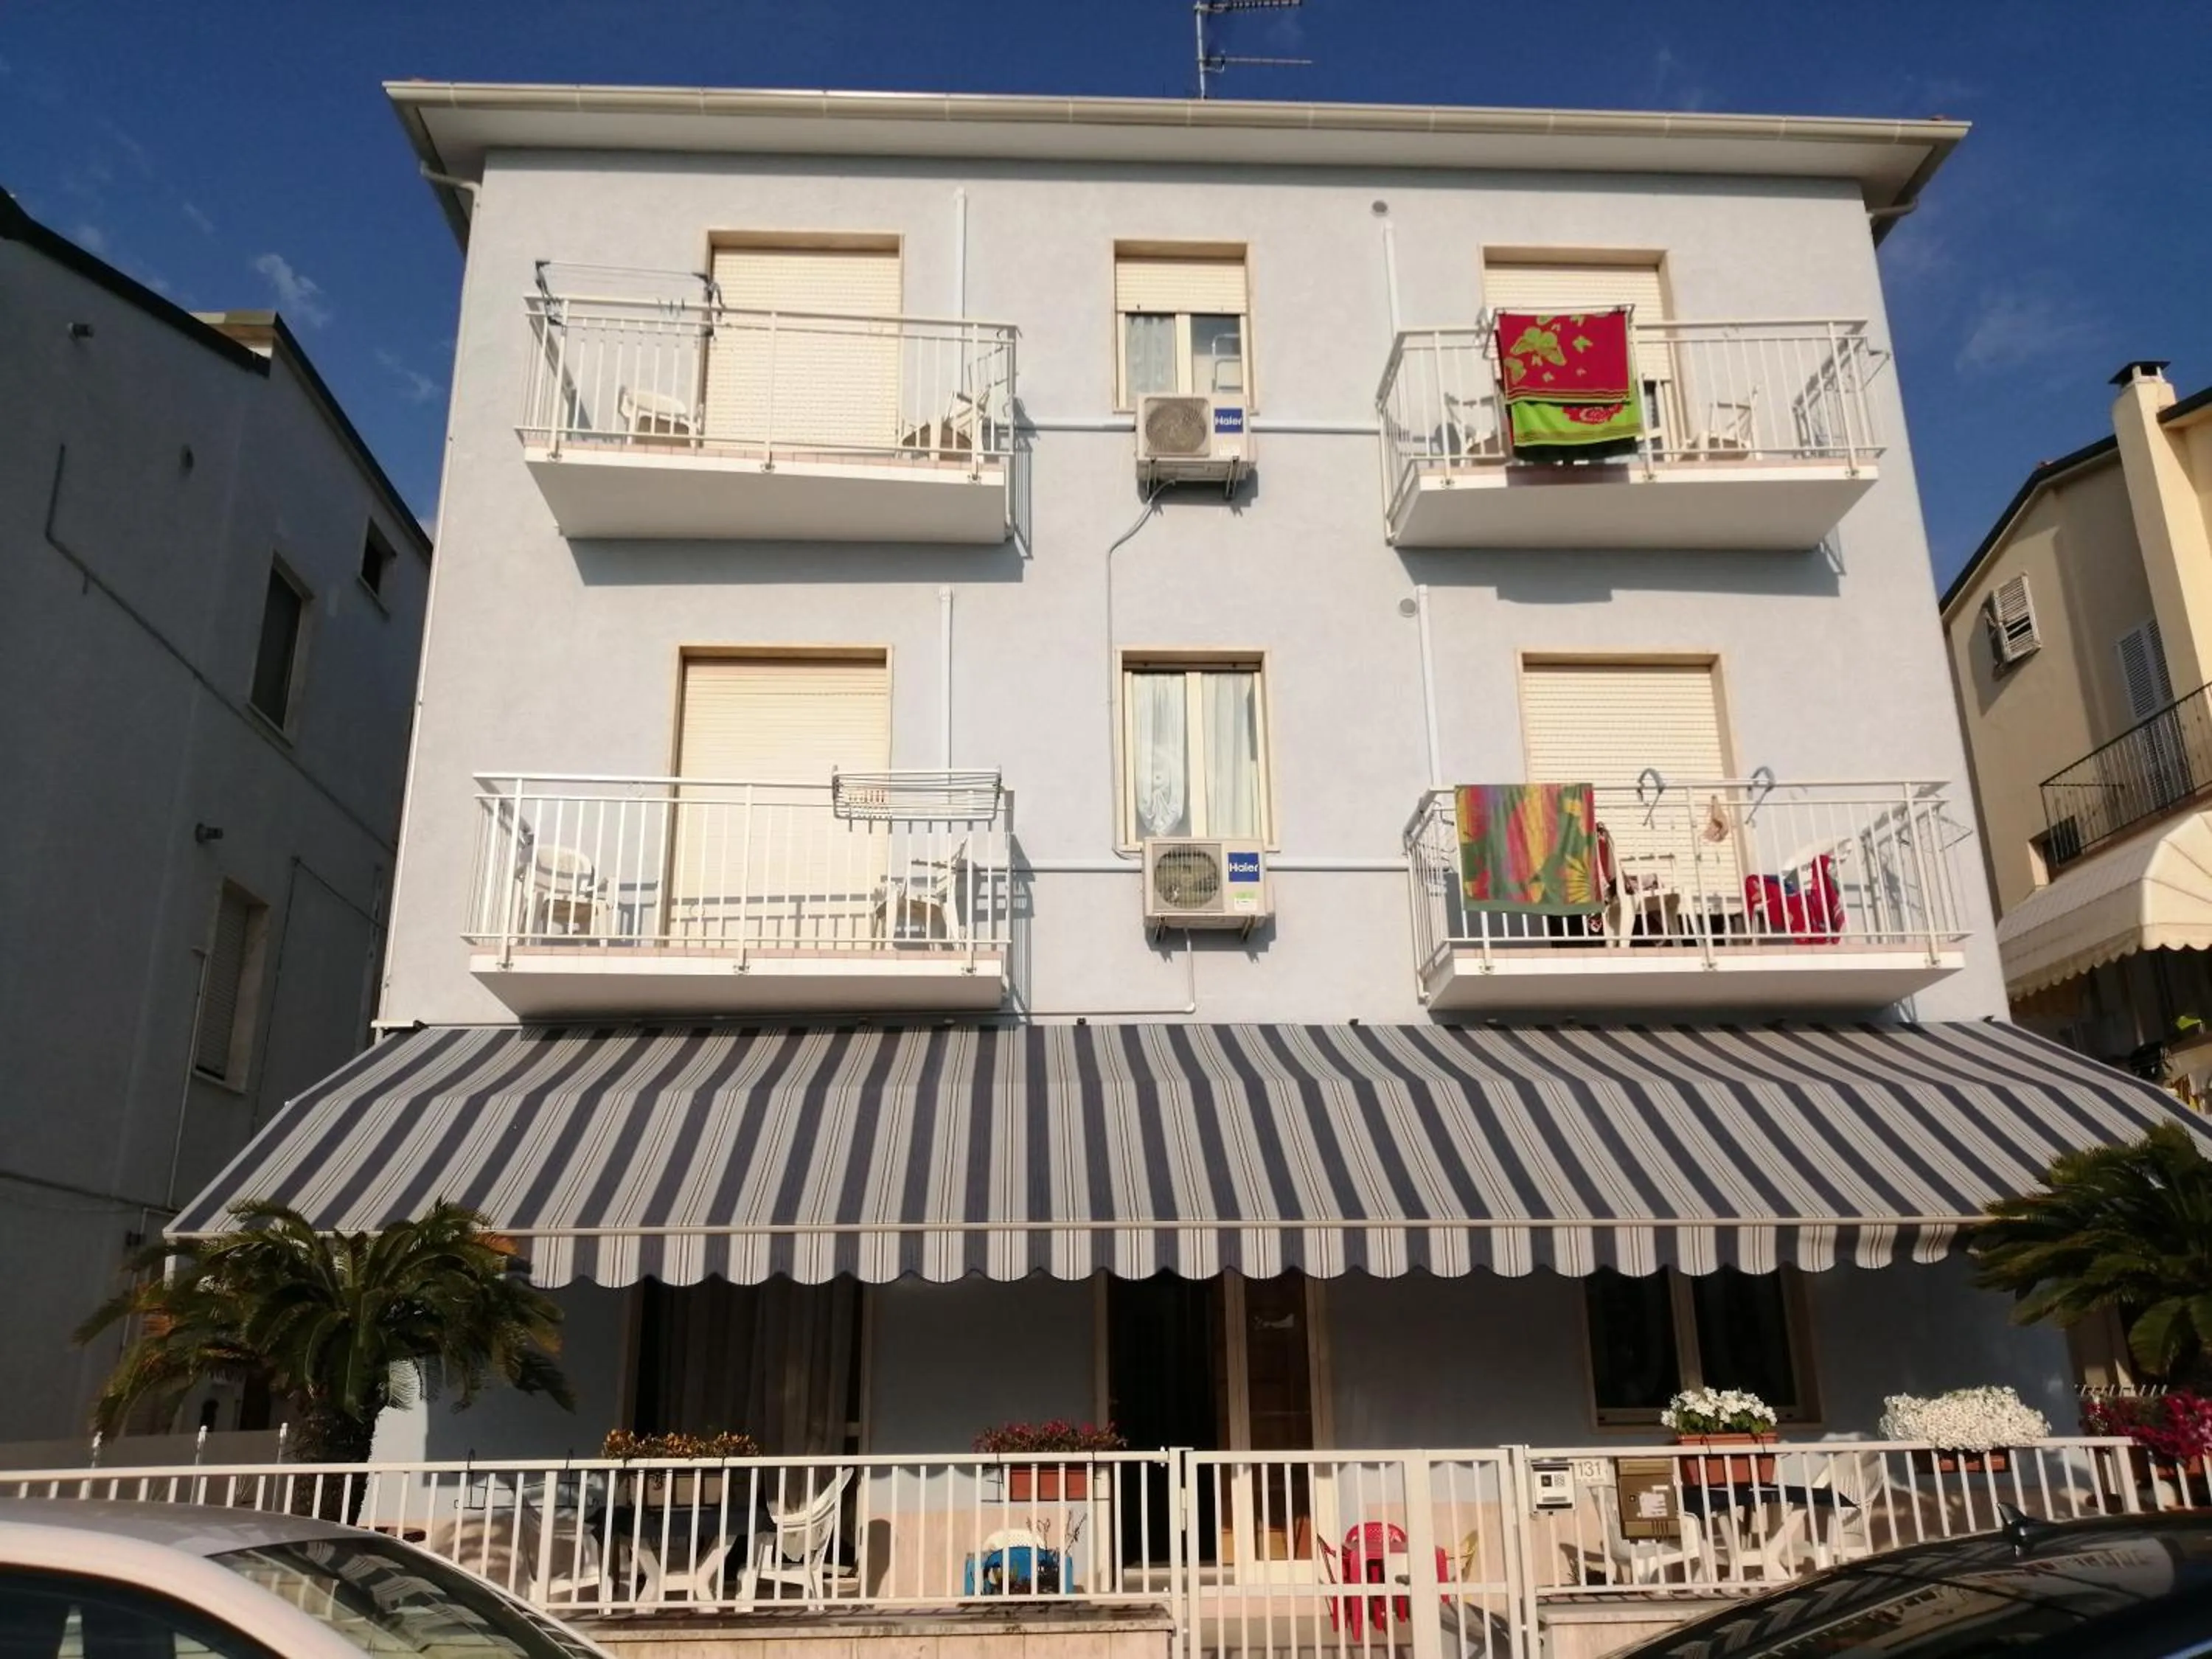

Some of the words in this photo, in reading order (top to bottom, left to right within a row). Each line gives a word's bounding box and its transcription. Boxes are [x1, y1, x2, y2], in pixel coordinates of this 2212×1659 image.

[1215, 416, 1242, 426] Haier
[1230, 863, 1258, 872] Haier
[1579, 1461, 1601, 1477] 131
